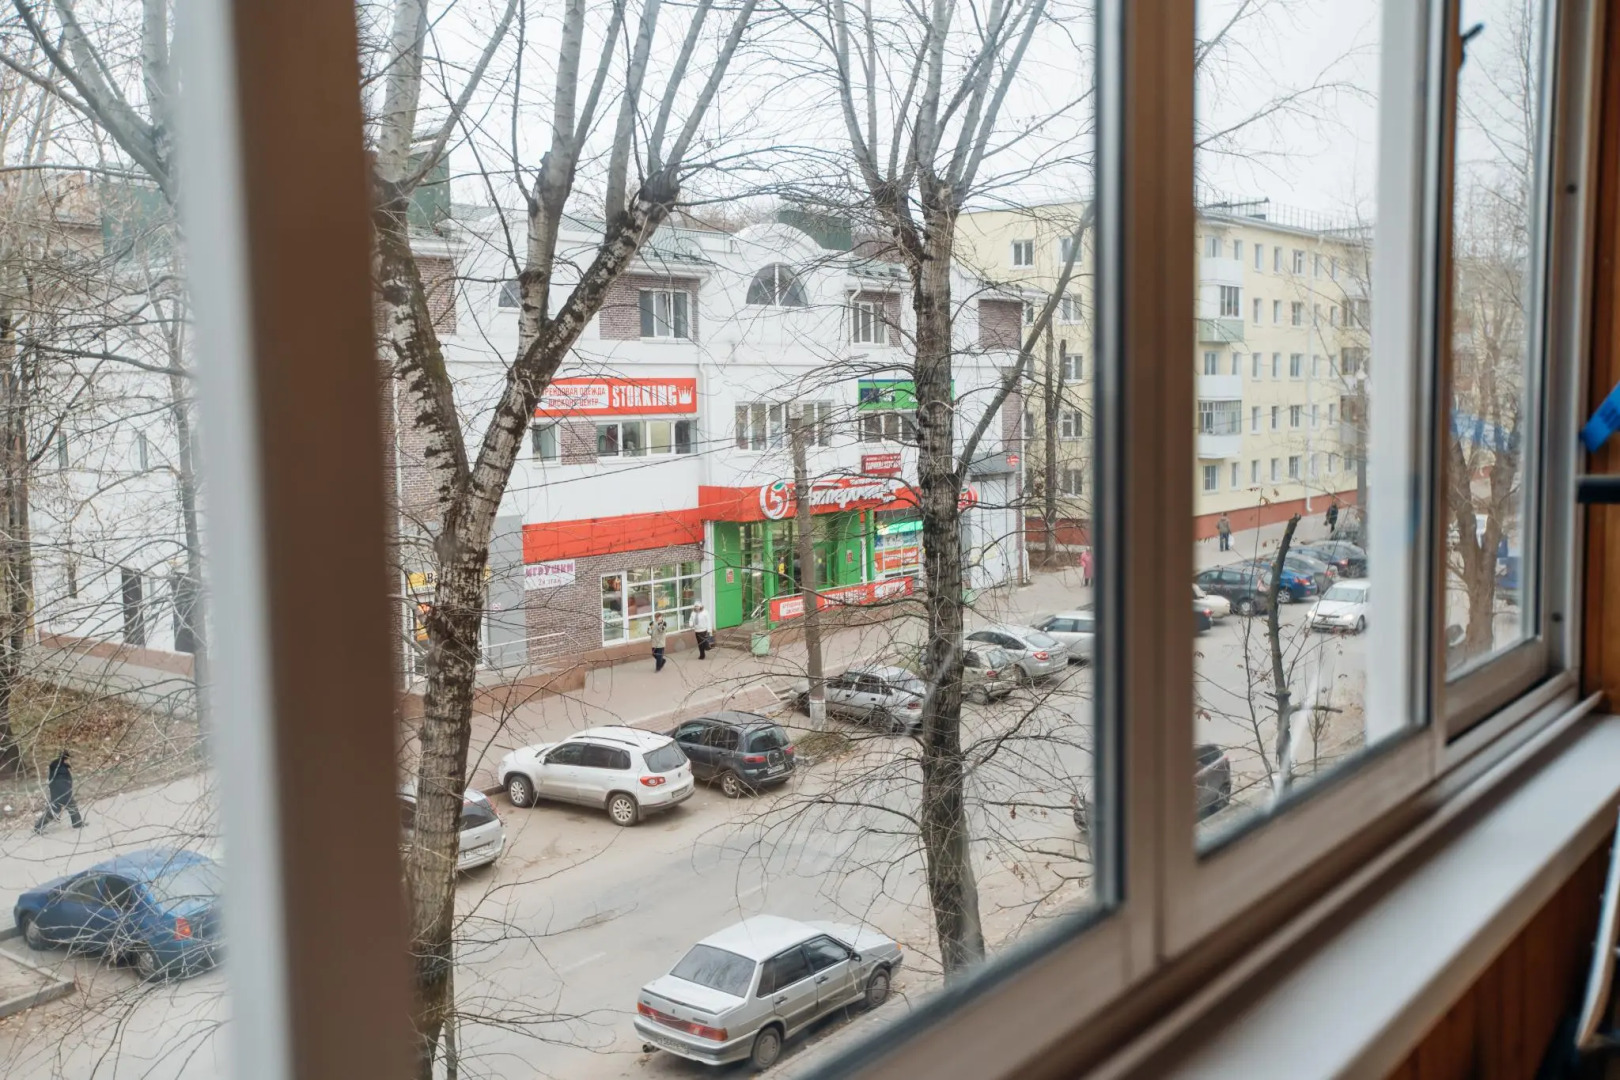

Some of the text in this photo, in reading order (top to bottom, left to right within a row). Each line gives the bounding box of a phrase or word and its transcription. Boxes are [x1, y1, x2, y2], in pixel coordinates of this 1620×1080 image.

[543, 387, 578, 396] РЕНДОВАЯ
[612, 384, 678, 408] STOKKING
[525, 563, 574, 577] ИГРУШКИ
